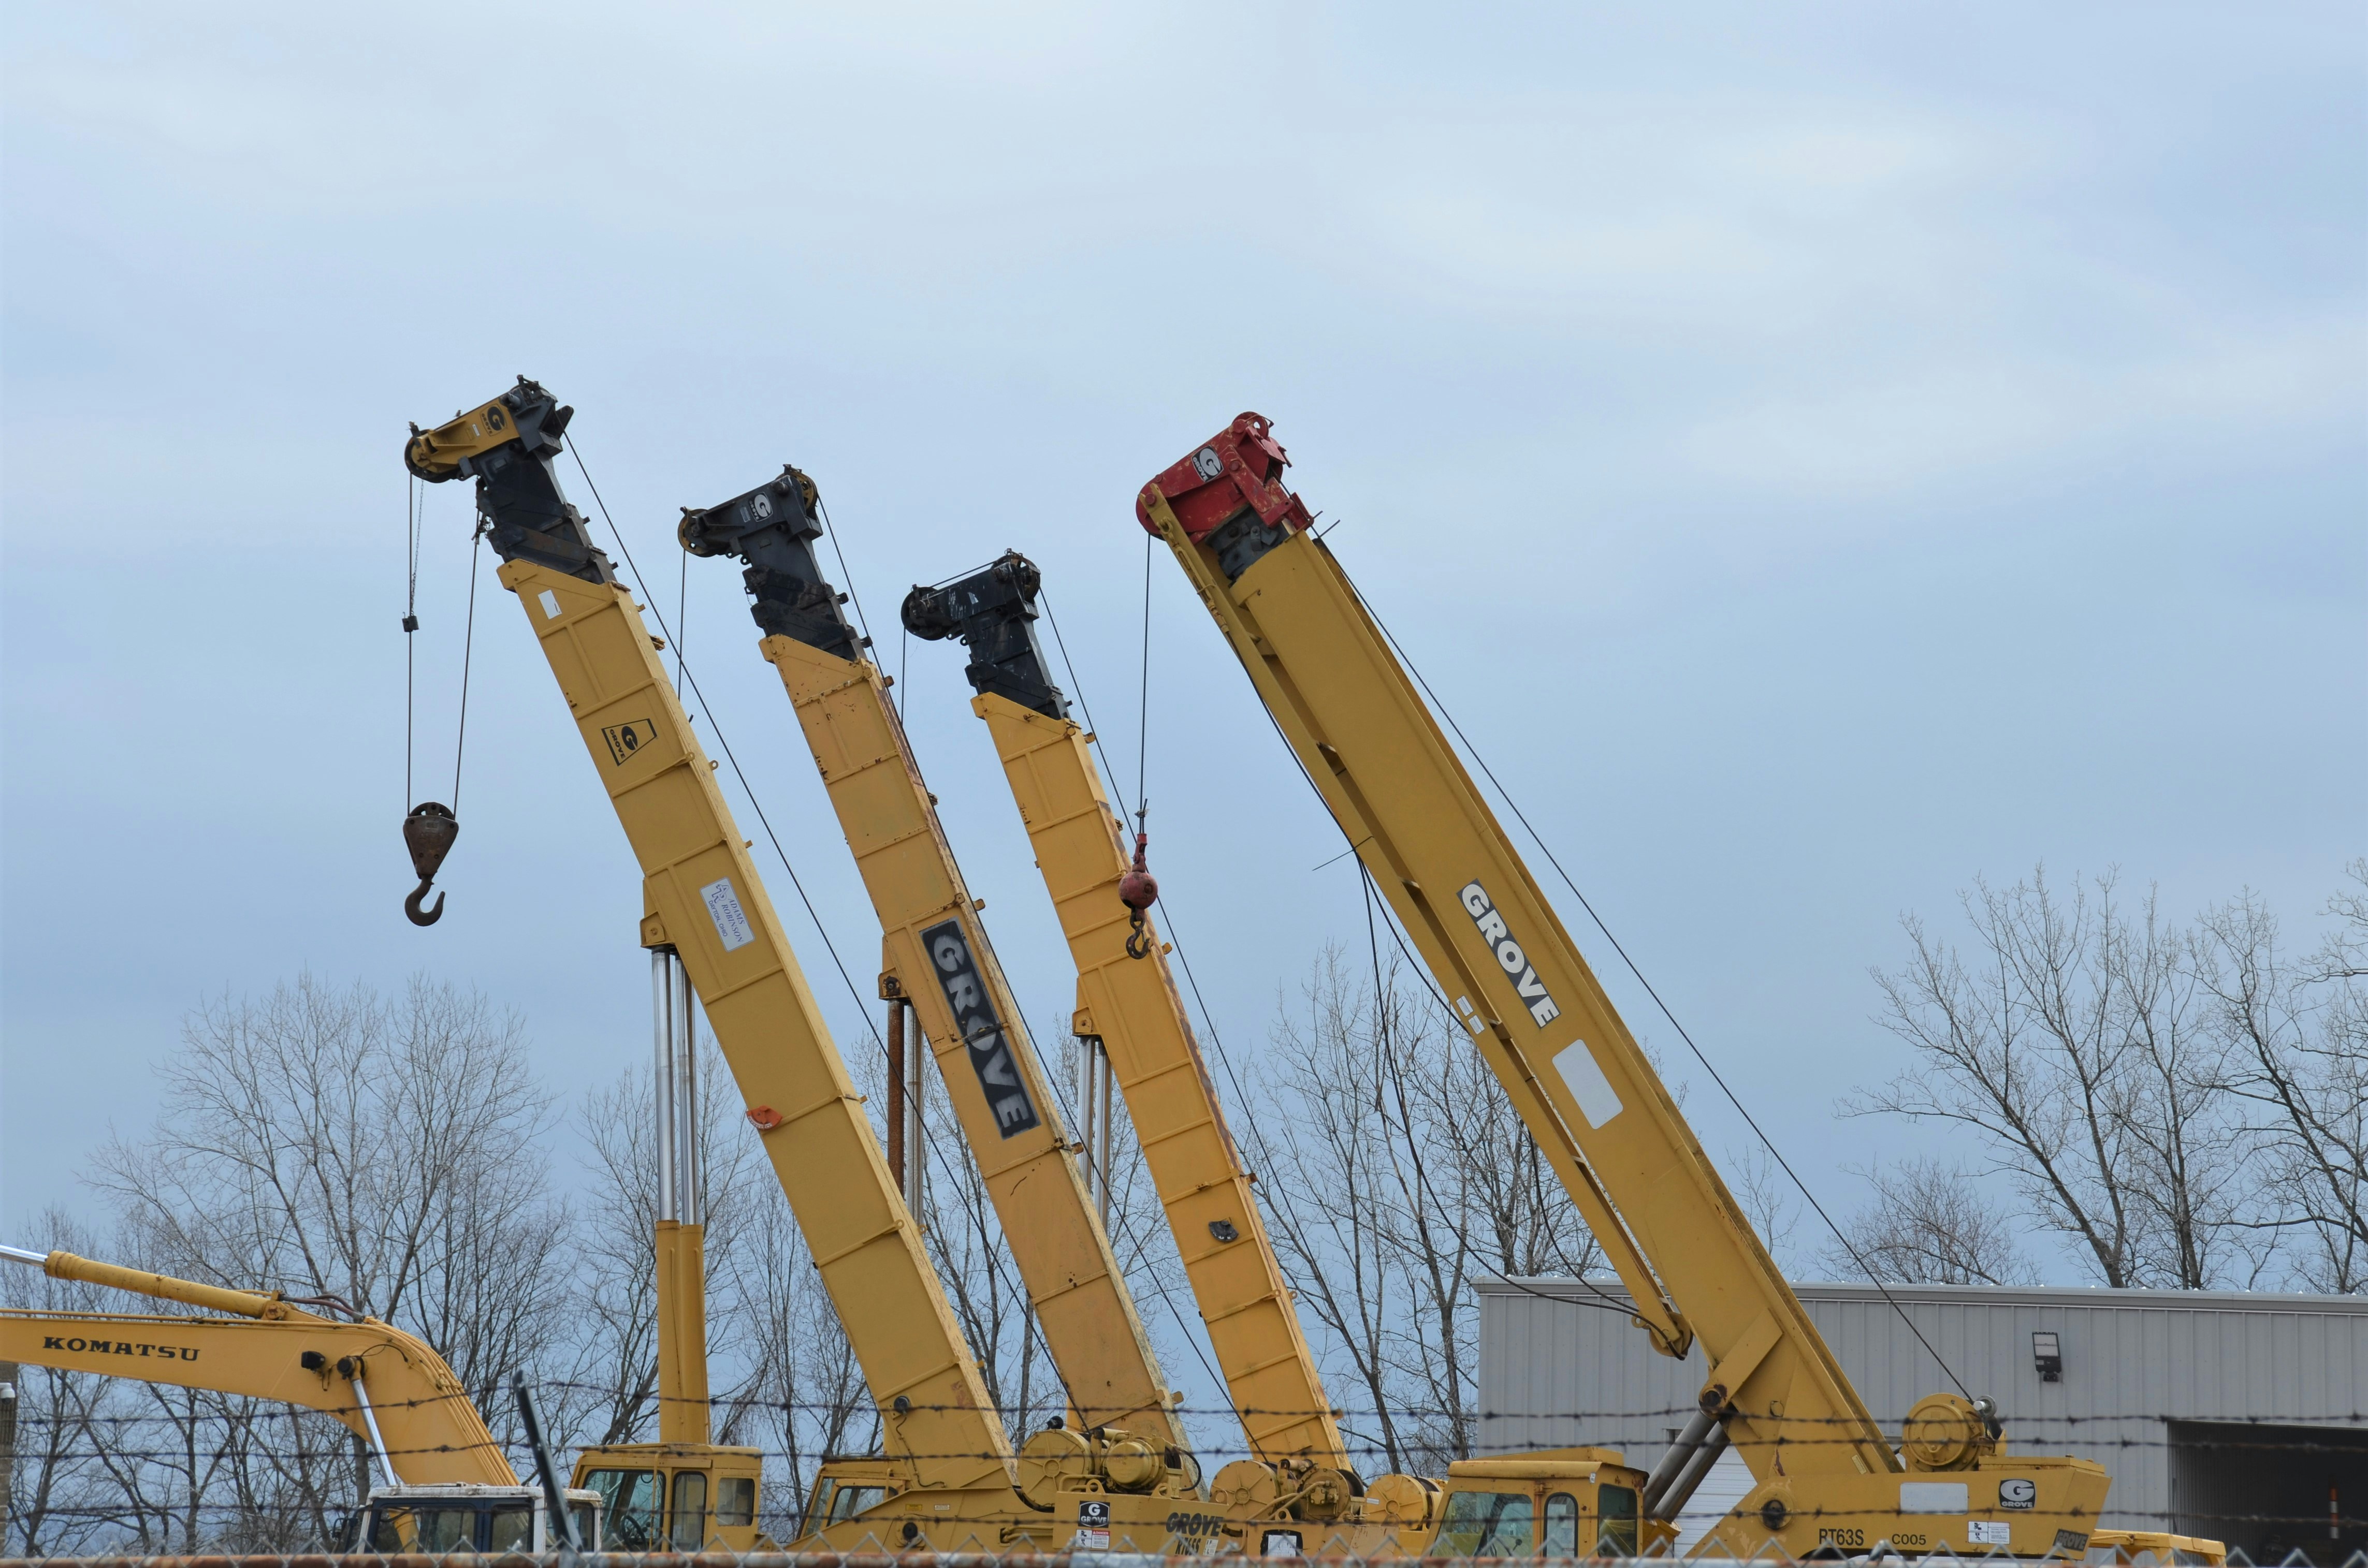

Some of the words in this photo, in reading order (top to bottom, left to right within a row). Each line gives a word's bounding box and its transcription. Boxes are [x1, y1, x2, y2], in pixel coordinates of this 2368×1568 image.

[1193, 457, 1208, 481] GROVE
[1199, 448, 1221, 476] G
[749, 500, 759, 520] GROVE
[754, 494, 771, 517] G
[610, 728, 626, 759] GROVE
[621, 726, 638, 751] G
[708, 900, 721, 922] DAYTON,
[719, 923, 728, 937] OHIO
[721, 904, 744, 942] ROBINSON
[728, 898, 745, 925] ADAMS
[1462, 884, 1560, 1028] GROVE
[934, 934, 1030, 1128] GROVE
[42, 1336, 200, 1361] KOMATSU
[2000, 1480, 2034, 1501] G
[1088, 1503, 1100, 1516] G
[1166, 1512, 1225, 1537] GROVE
[1819, 1528, 1864, 1546] RT63S
[2055, 1531, 2087, 1549] GROVE
